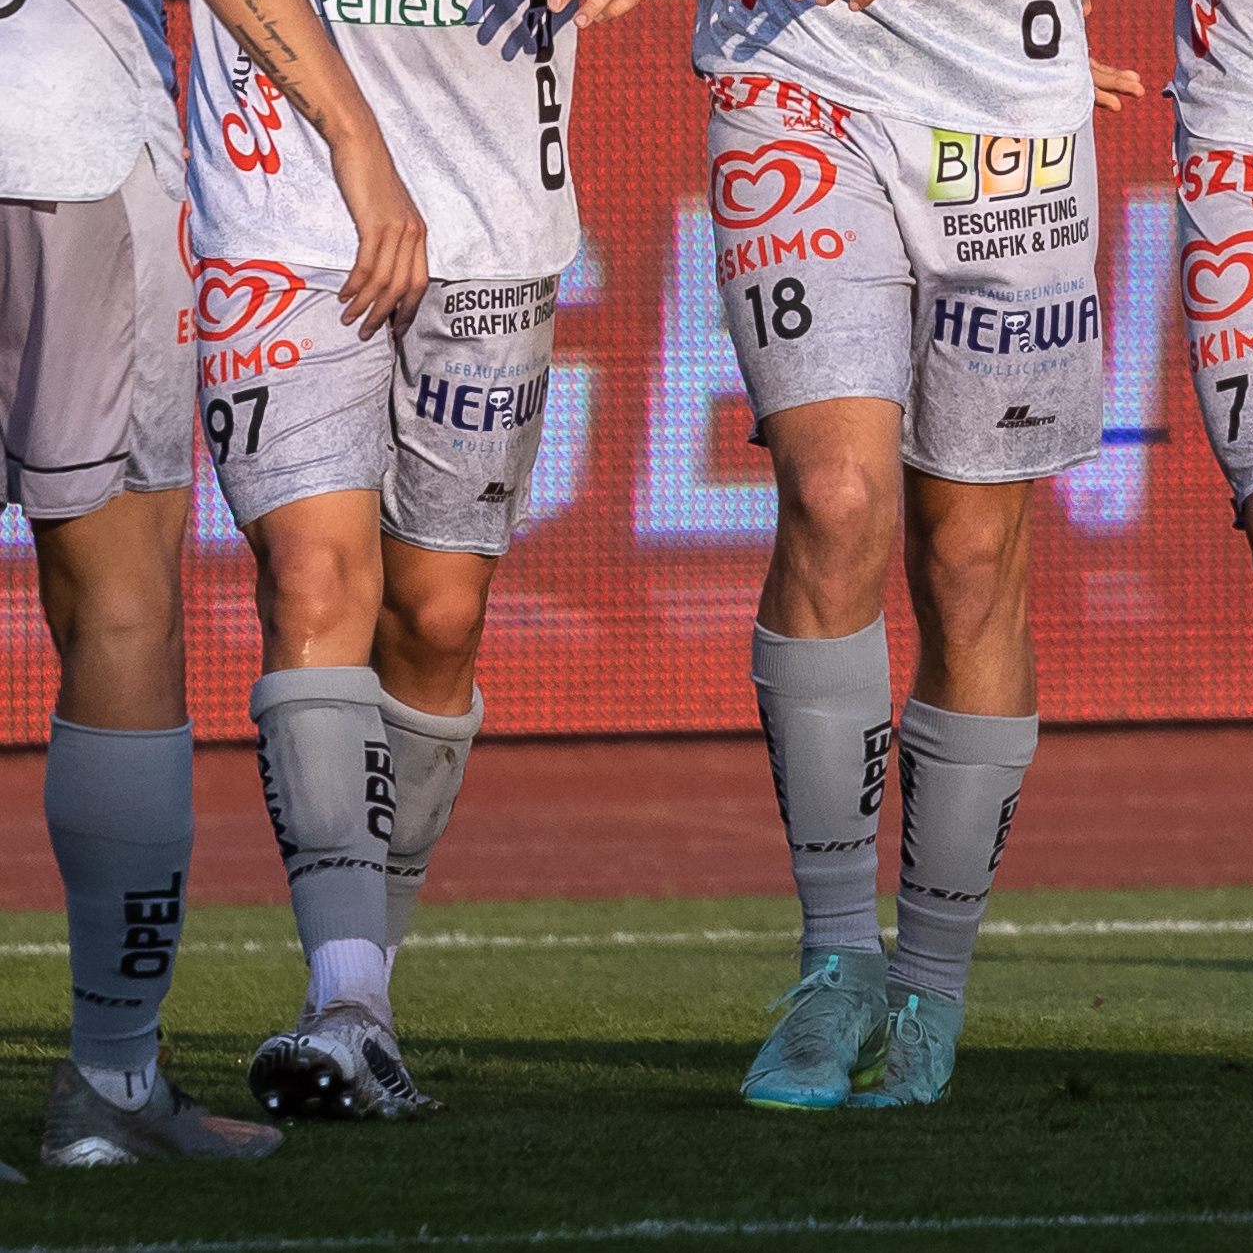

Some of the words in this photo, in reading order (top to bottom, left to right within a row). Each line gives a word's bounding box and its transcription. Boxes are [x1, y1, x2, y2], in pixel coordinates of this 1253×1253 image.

[943, 197, 1078, 237] BESCHRIFTUNG
[956, 233, 1028, 263] GRAFIK
[1032, 231, 1045, 253] &
[450, 312, 519, 338] GRAFIK
[520, 312, 532, 330] &
[745, 277, 812, 349] 18
[206, 385, 269, 466] 97
[1216, 374, 1250, 444] 7
[120, 871, 182, 980] OPEL
